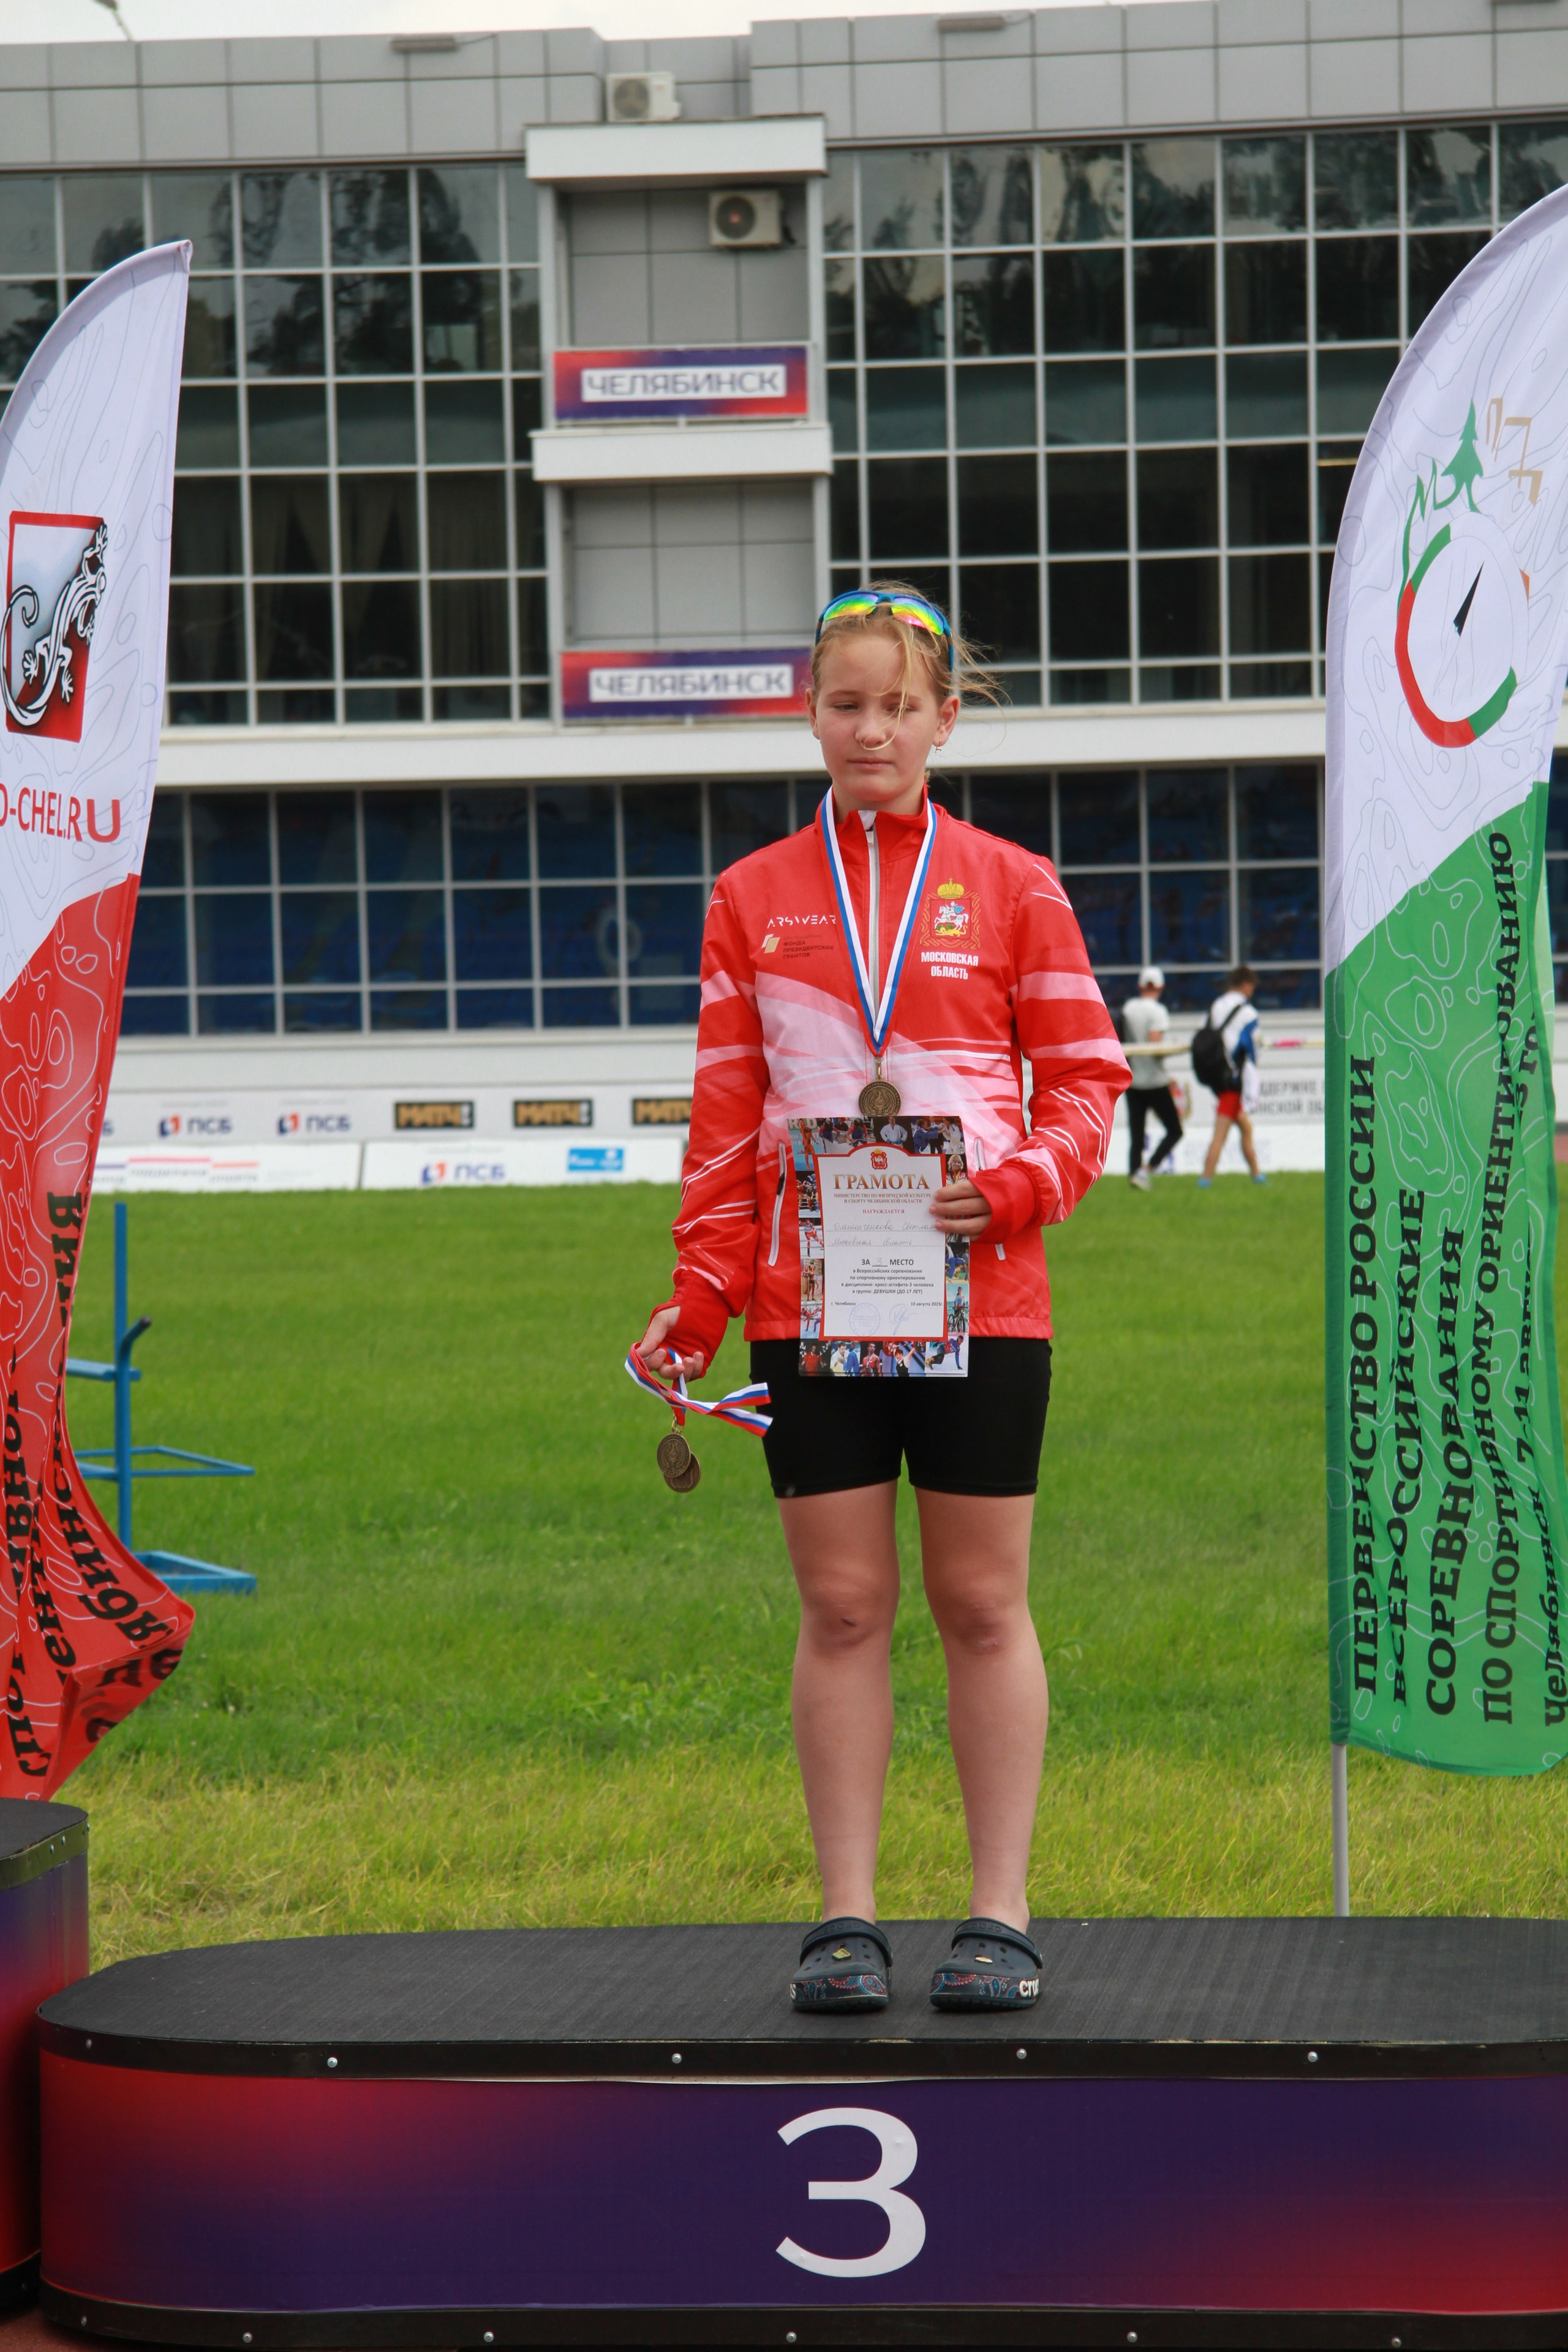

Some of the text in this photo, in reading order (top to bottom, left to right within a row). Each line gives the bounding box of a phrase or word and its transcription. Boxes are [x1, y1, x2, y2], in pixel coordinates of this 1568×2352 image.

[587, 371, 780, 396] ЧЕЛЯБИНСК
[594, 671, 786, 697] ЧЕЛЯБИНСК
[767, 914, 836, 929] ARSWEAR
[921, 951, 979, 967] МОСКОВСКАЯ
[930, 965, 968, 980] ОБЛАСТЬ
[833, 1174, 930, 1190] ГРАМОТА
[902, 1222, 937, 1231] Светлан
[1471, 832, 1520, 1725] ПО СПОРТИВНОМУ ОРИЕНТИРОВАНИЮ
[1349, 1055, 1379, 1695] ПЕРВЕНСТВО РОССИИ
[1387, 1188, 1425, 1707] ВСЕРОССИЙСКИЕ
[1426, 1226, 1474, 1715] СОРЕВНОВАНИЯ
[775, 2107, 926, 2278] 3
